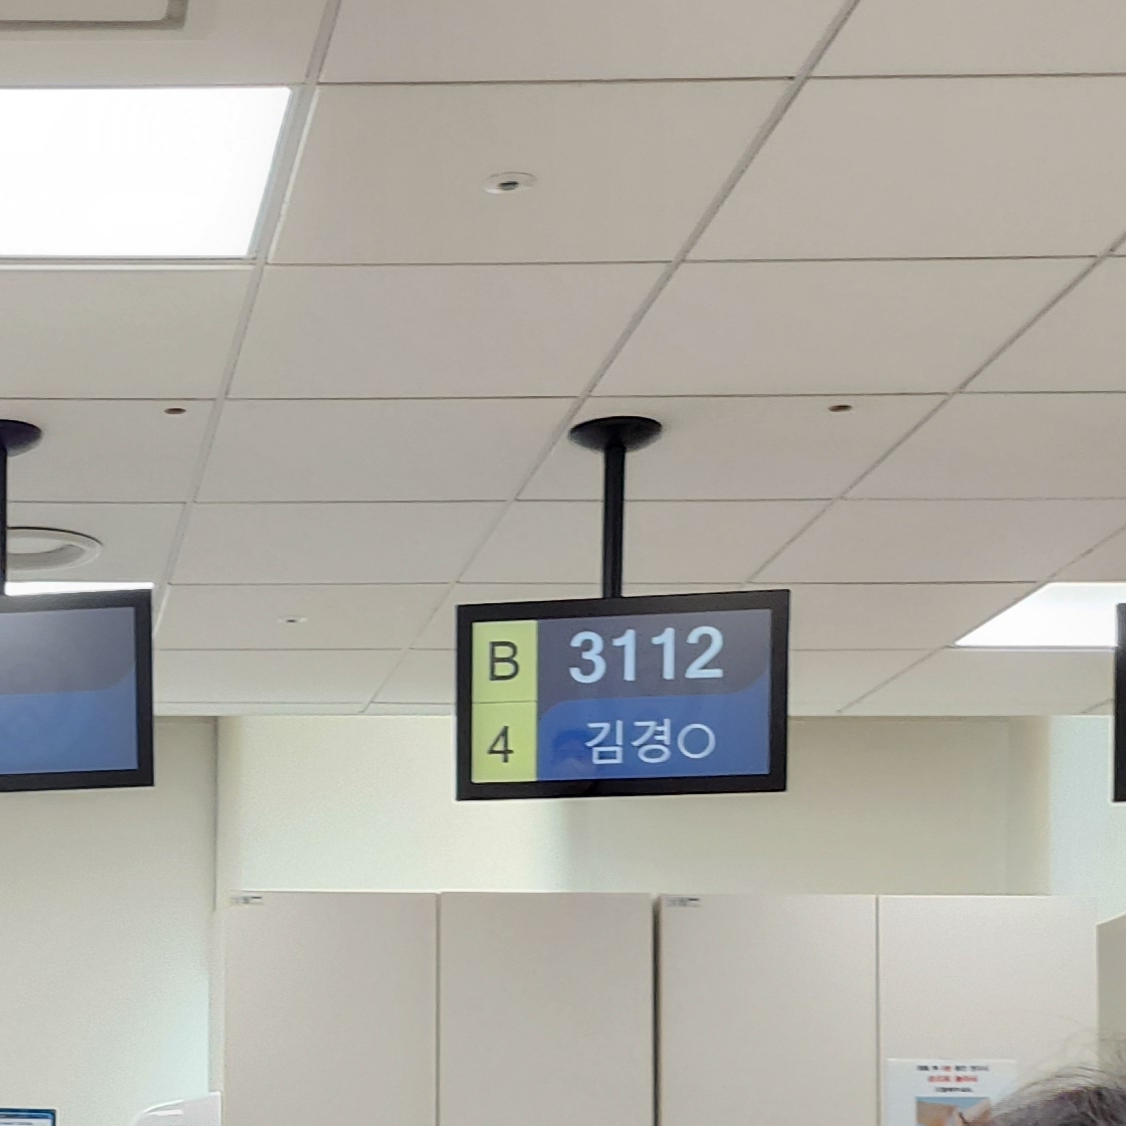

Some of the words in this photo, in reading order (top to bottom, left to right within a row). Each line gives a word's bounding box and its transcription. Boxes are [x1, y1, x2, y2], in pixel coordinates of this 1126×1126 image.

[489, 641, 520, 681] B
[568, 625, 724, 684] 3112
[487, 725, 515, 763] 4
